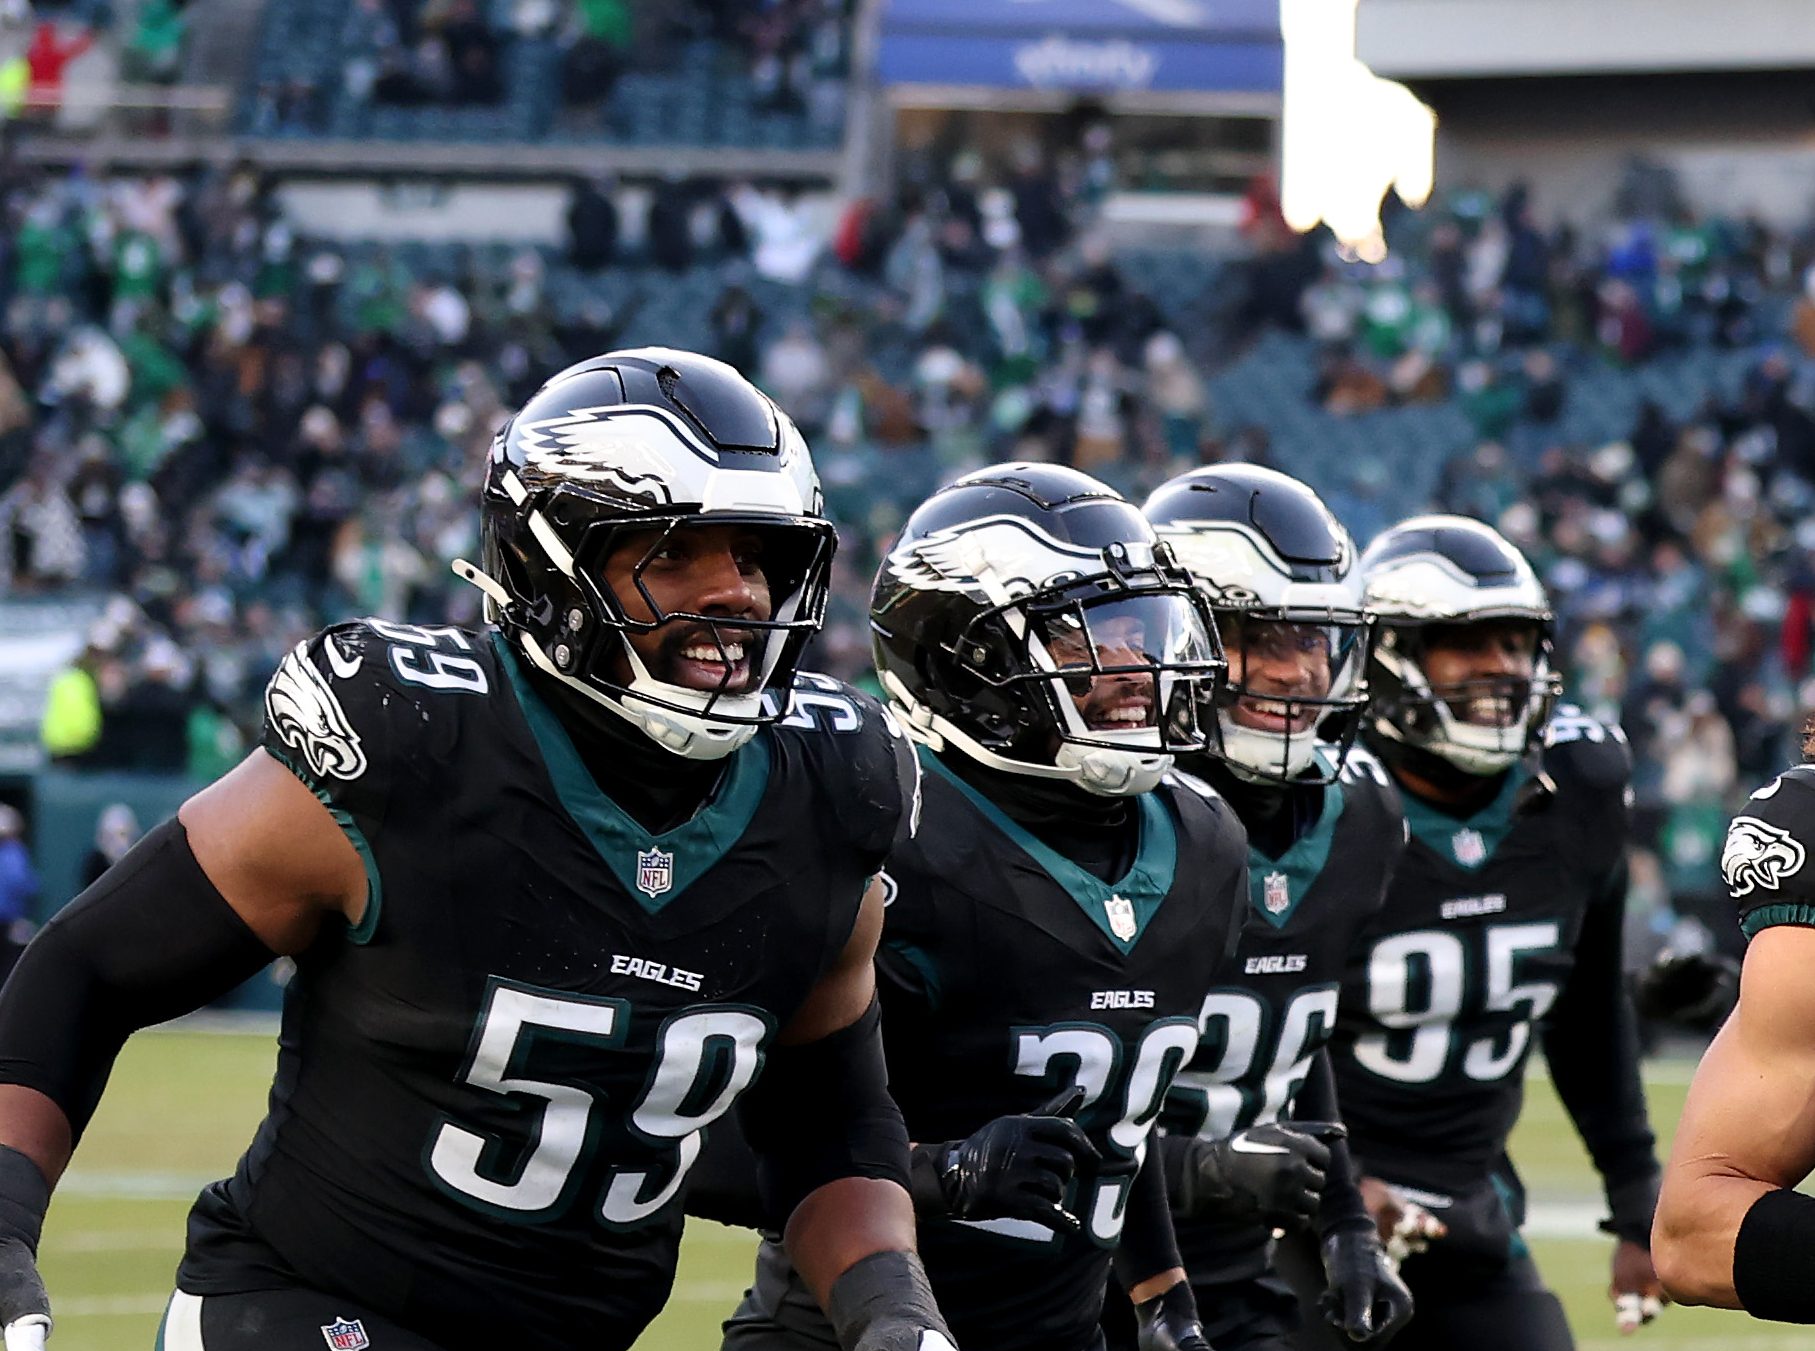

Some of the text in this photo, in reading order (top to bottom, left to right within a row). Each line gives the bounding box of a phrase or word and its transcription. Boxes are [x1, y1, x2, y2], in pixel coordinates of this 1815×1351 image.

[642, 869, 667, 888] NFL
[610, 954, 705, 992] EAGLES
[1244, 954, 1308, 975] EAGLES
[1090, 991, 1155, 1010] EAGLES
[1353, 922, 1560, 1083] 95
[429, 983, 768, 1224] 59
[334, 1333, 363, 1348] NFL
